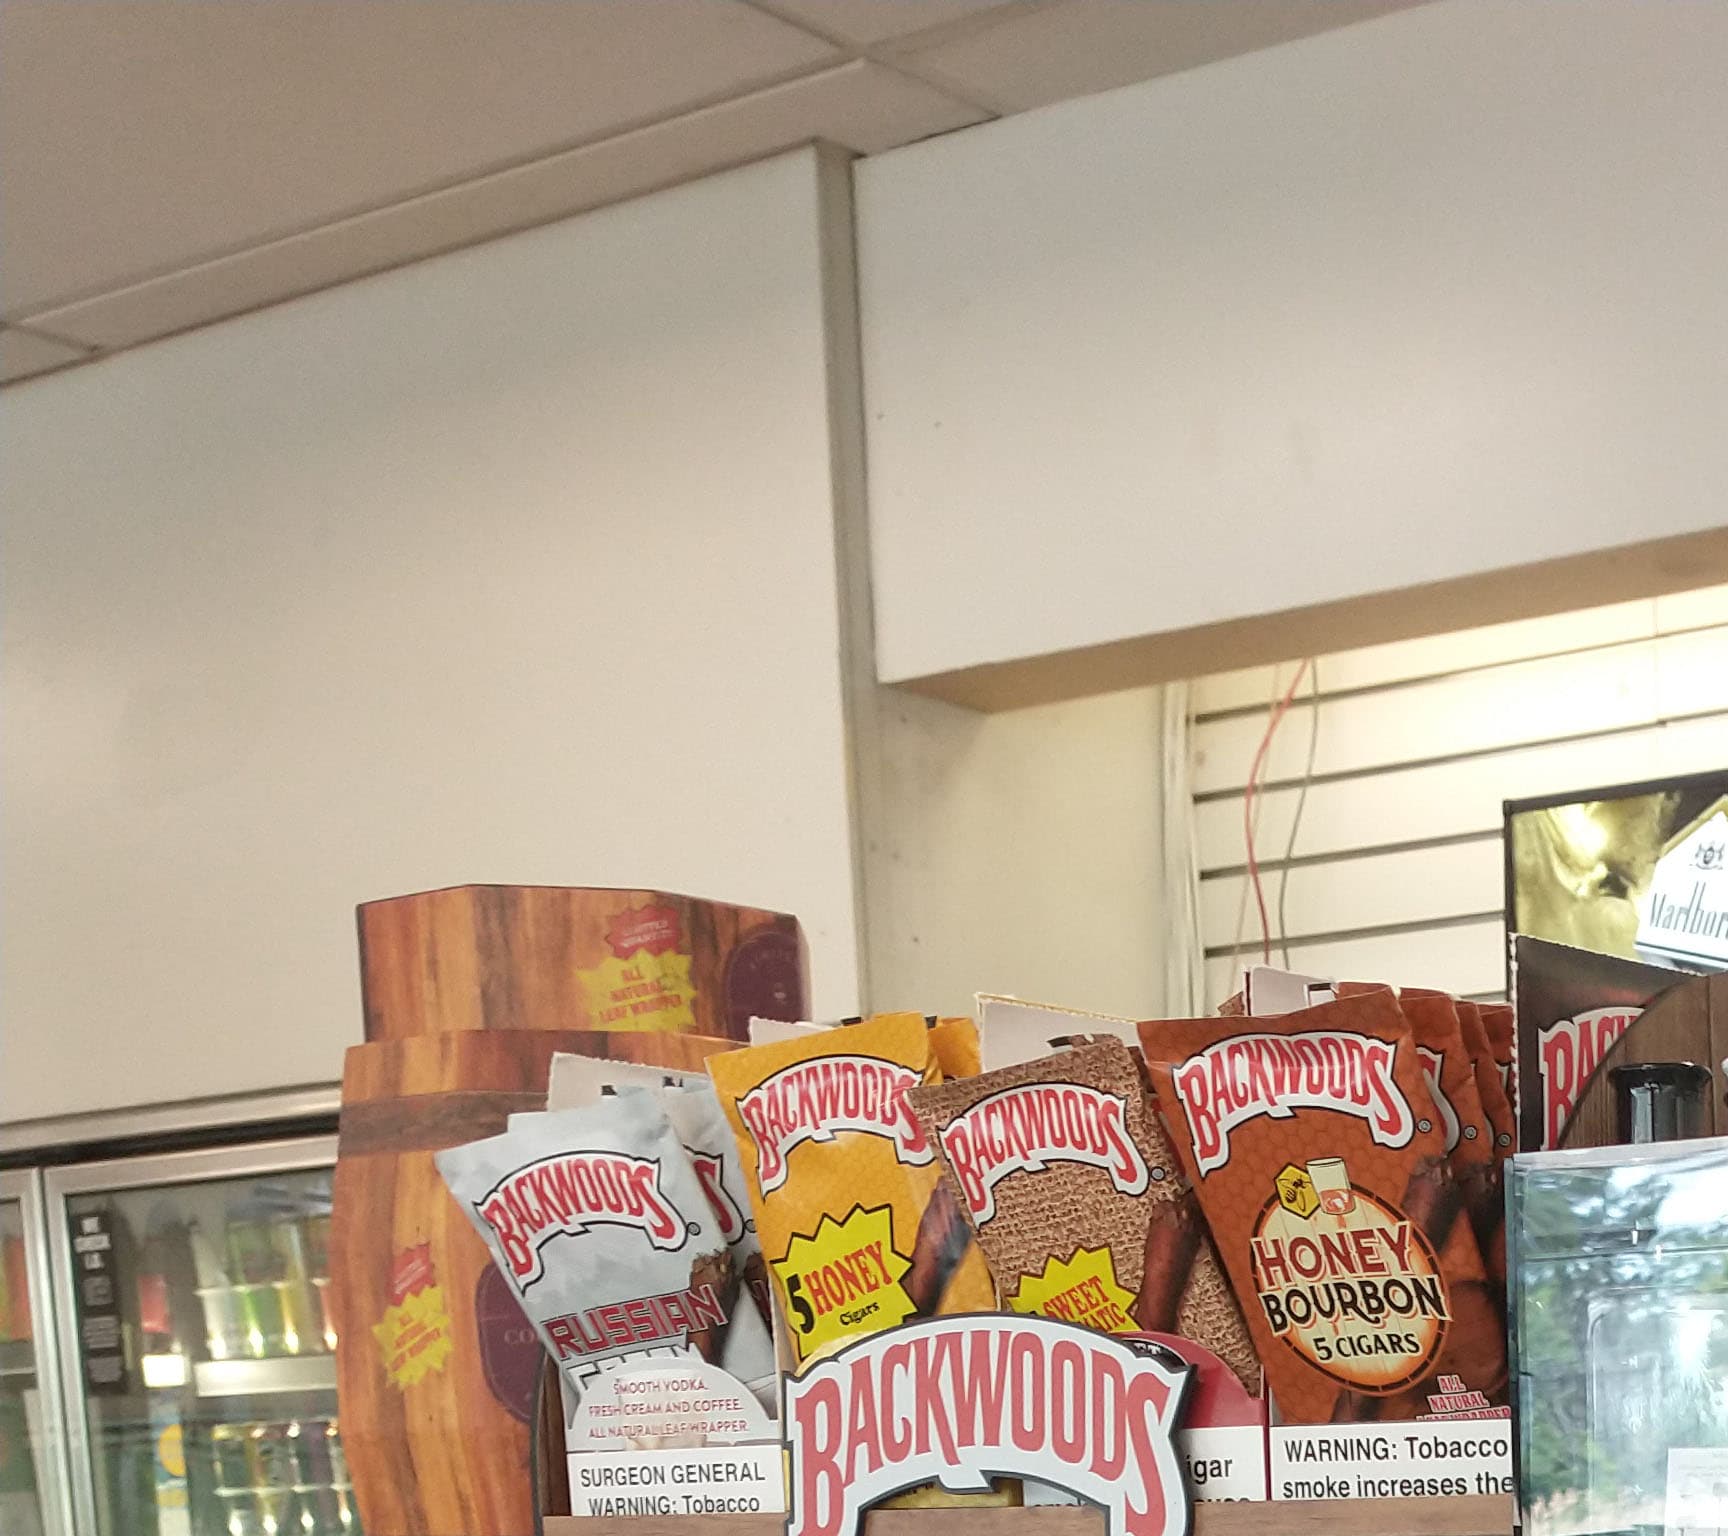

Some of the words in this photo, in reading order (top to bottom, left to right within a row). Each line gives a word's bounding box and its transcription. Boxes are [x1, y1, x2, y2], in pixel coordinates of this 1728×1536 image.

[742, 1058, 933, 1186] BACKWOODS
[1177, 1036, 1412, 1168] BACKWOODS
[945, 1087, 1149, 1218] BACKWOODS
[483, 1157, 688, 1283] BACKWOODS
[1254, 1222, 1412, 1285] HONEY
[789, 1280, 812, 1335] 5
[804, 1241, 892, 1309] HONEY
[1043, 1275, 1110, 1320] SWEET
[1262, 1277, 1448, 1333] BOURBON
[546, 1283, 732, 1359] RUSSIAN
[1314, 1335, 1332, 1361] 5
[1336, 1332, 1421, 1358] CIGARS
[589, 1406, 621, 1416] FRESH
[624, 1403, 661, 1415] CREAM
[666, 1401, 690, 1412] AND
[694, 1399, 744, 1411] COFFEE.
[614, 1382, 659, 1394] SMOOTH
[664, 1379, 709, 1391] VODKA.
[581, 1466, 665, 1487] SURGEON
[671, 1462, 765, 1483] GENERAL
[1284, 1438, 1398, 1462] WARNING:
[1404, 1437, 1509, 1461] Tobacco
[589, 1497, 676, 1516] WARNING:
[682, 1495, 760, 1514] Tobacco
[1283, 1477, 1351, 1498] smoke
[1356, 1476, 1471, 1497] increases
[1476, 1475, 1514, 1496] the
